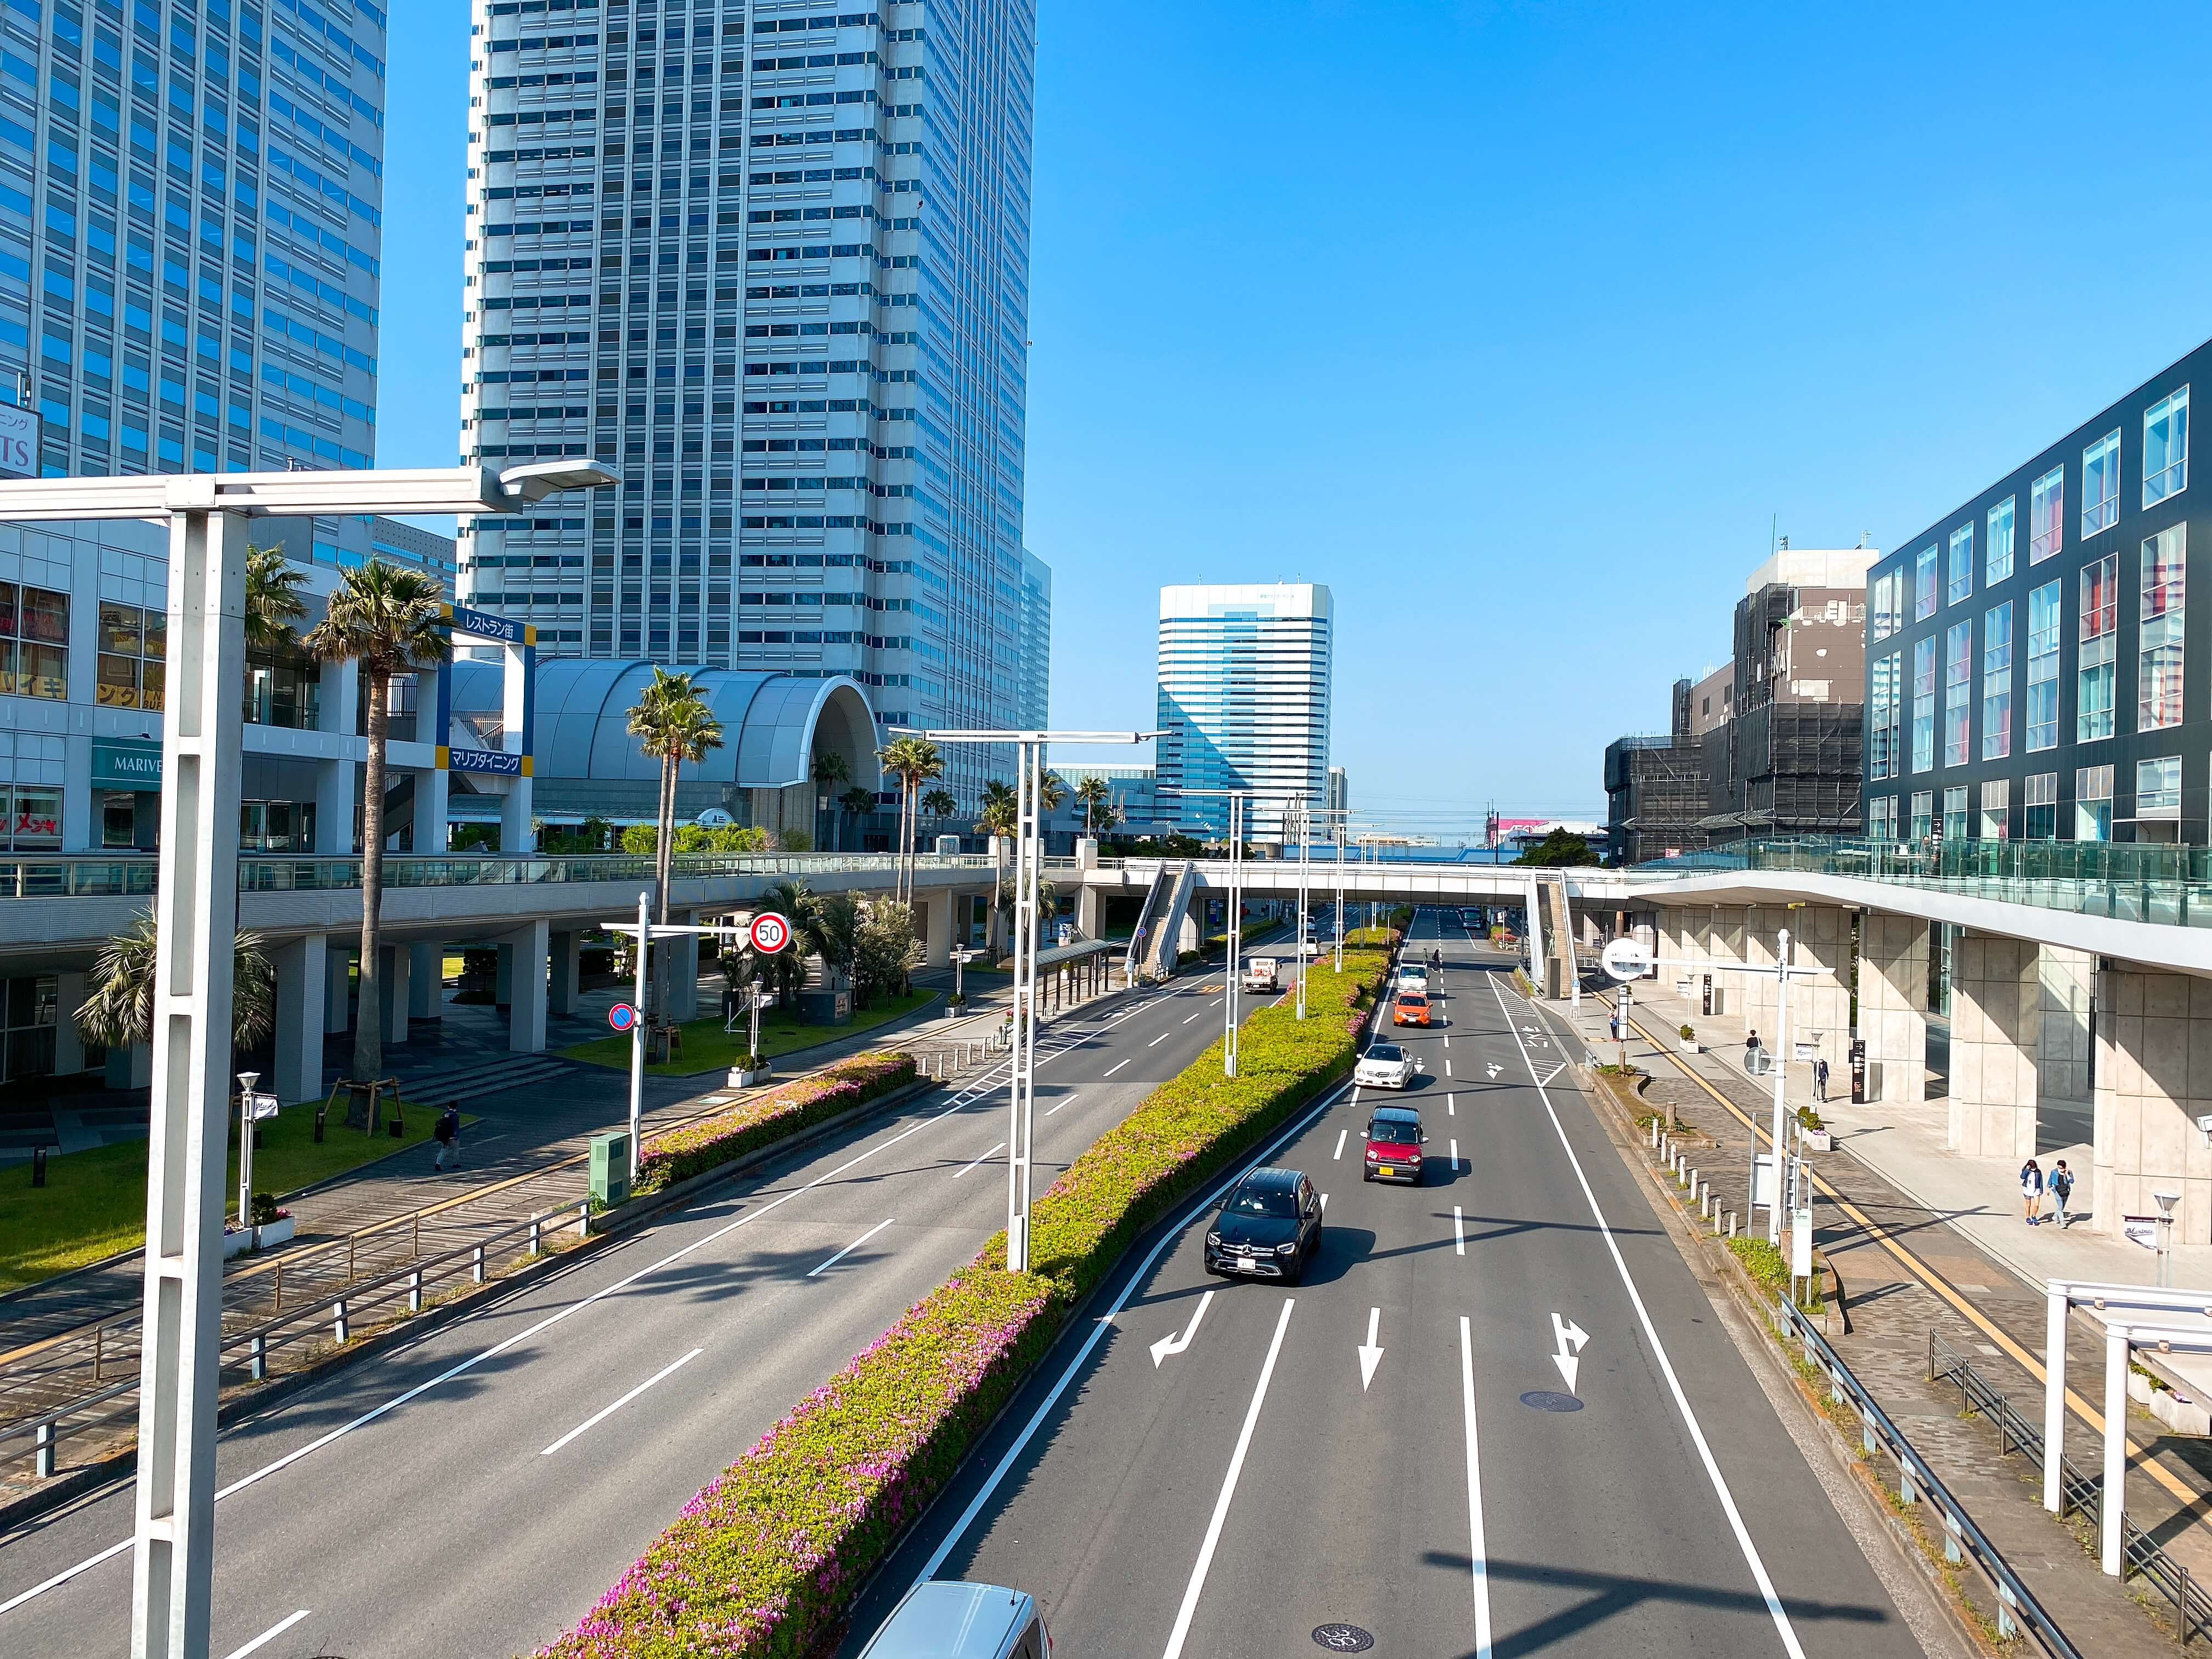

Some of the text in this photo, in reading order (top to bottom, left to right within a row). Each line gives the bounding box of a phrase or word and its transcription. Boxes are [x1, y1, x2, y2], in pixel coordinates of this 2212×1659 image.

[466, 614, 514, 639] レストラン街
[759, 925, 779, 941] 50
[1197, 985, 1226, 993] 50
